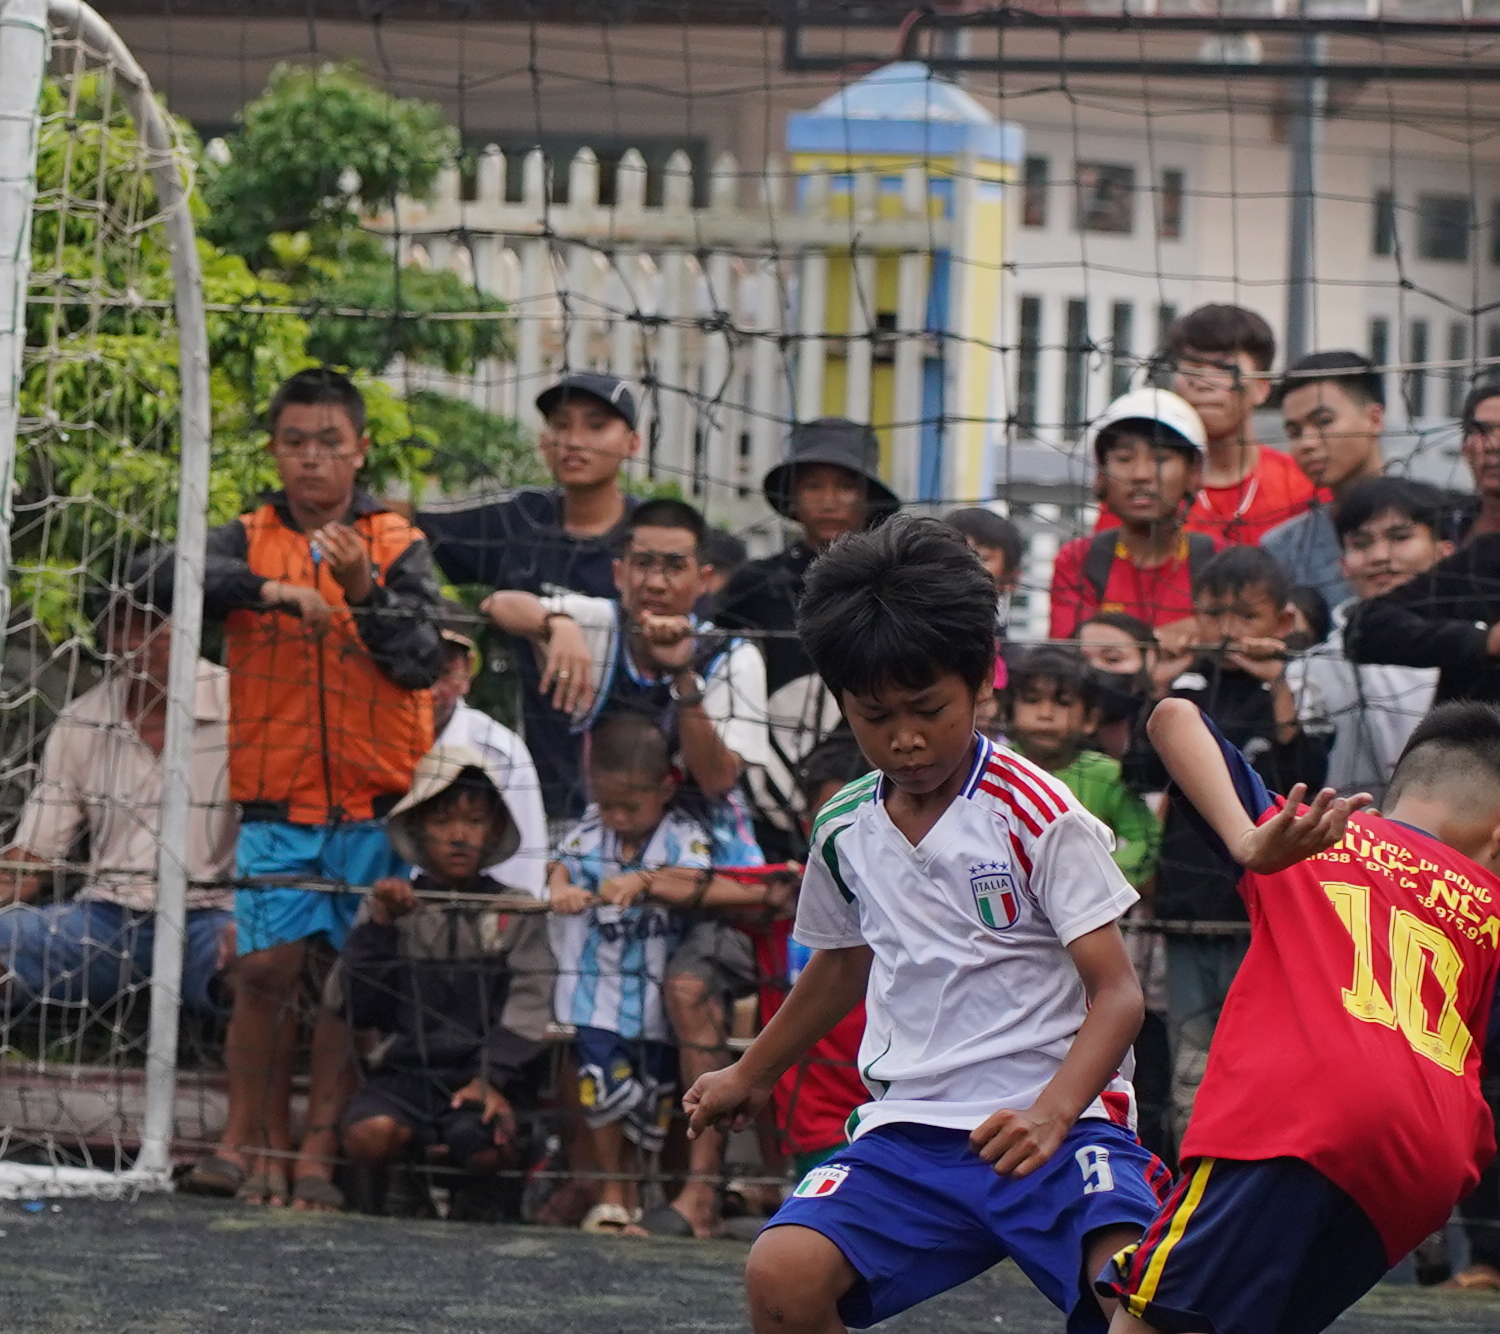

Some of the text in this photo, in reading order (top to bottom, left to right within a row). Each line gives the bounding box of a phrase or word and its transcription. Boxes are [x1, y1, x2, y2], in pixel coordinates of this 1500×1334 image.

[975, 878, 1009, 893] ITALIA
[1319, 881, 1474, 1077] 10
[1075, 1145, 1115, 1195] 9
